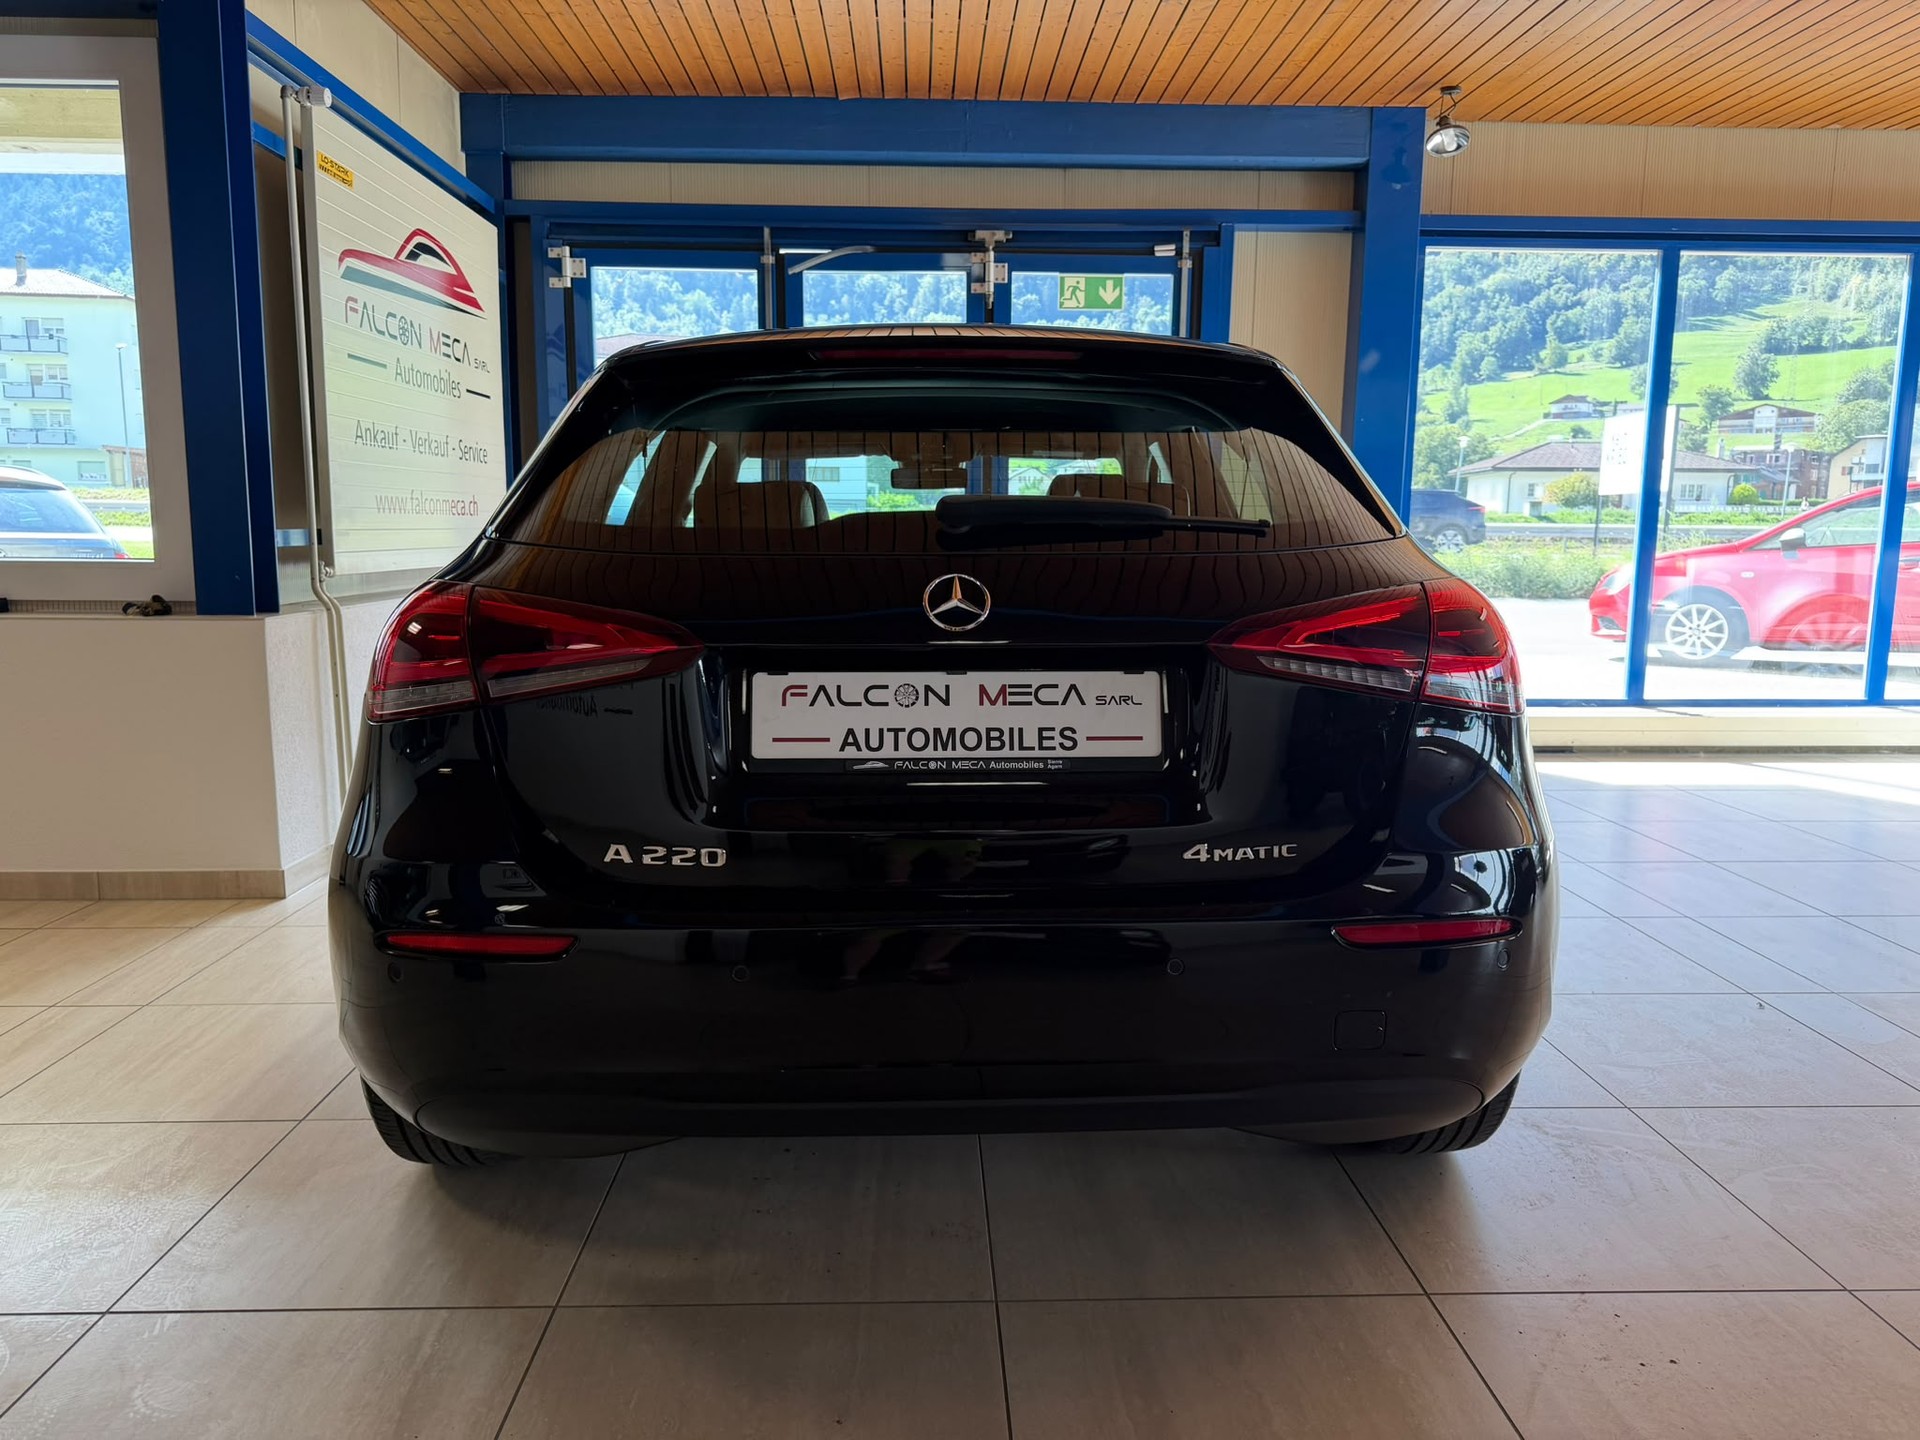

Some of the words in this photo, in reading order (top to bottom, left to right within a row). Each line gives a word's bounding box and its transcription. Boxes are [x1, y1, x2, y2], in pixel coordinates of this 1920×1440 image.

[345, 296, 422, 349] FALCON
[429, 327, 471, 366] MECA
[395, 357, 462, 399] Automobiles
[354, 419, 399, 451] Ankauf
[409, 429, 449, 458] Verkauf
[458, 439, 488, 464] Service
[375, 489, 479, 517] www.falconmeca.ch
[781, 683, 950, 708] FALCON
[979, 683, 1087, 706] MECA
[1095, 694, 1143, 706] SARL
[838, 726, 1079, 753] AUTOMOBILES
[894, 760, 947, 770] FALCON
[952, 760, 986, 770] MECA
[989, 760, 1045, 770] Automobiles
[603, 843, 634, 864] A
[641, 845, 727, 867] 220
[1182, 843, 1298, 863] 4MATIC
